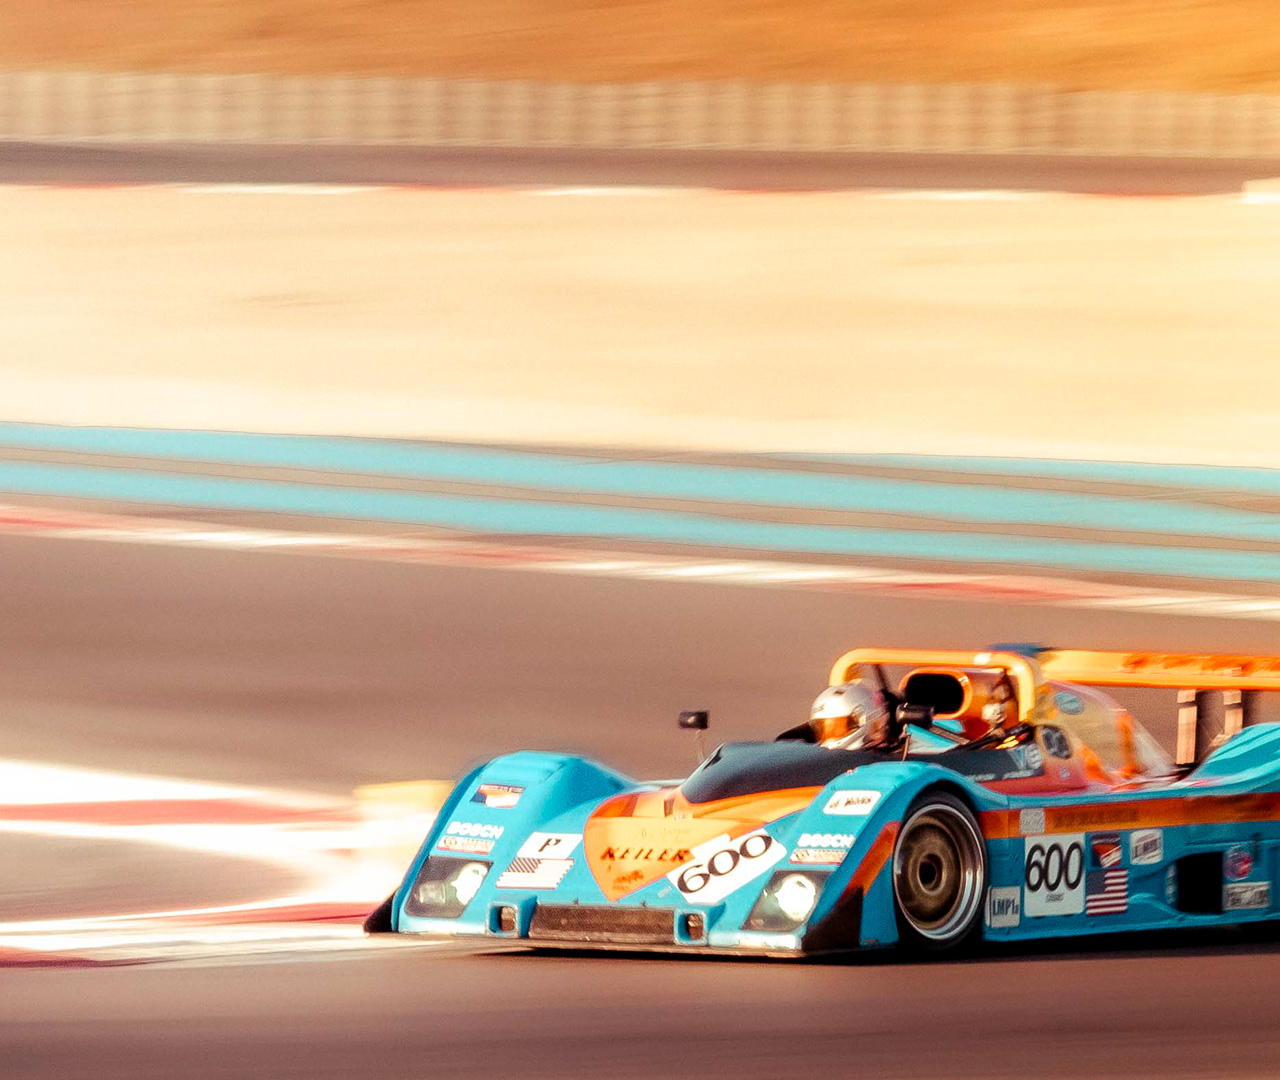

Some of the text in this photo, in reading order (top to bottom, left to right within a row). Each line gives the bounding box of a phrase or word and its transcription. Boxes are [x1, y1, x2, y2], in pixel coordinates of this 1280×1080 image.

[446, 821, 504, 839] BOSCH
[797, 833, 856, 848] BOSCH
[676, 834, 773, 894] 600
[1025, 842, 1084, 892] 600
